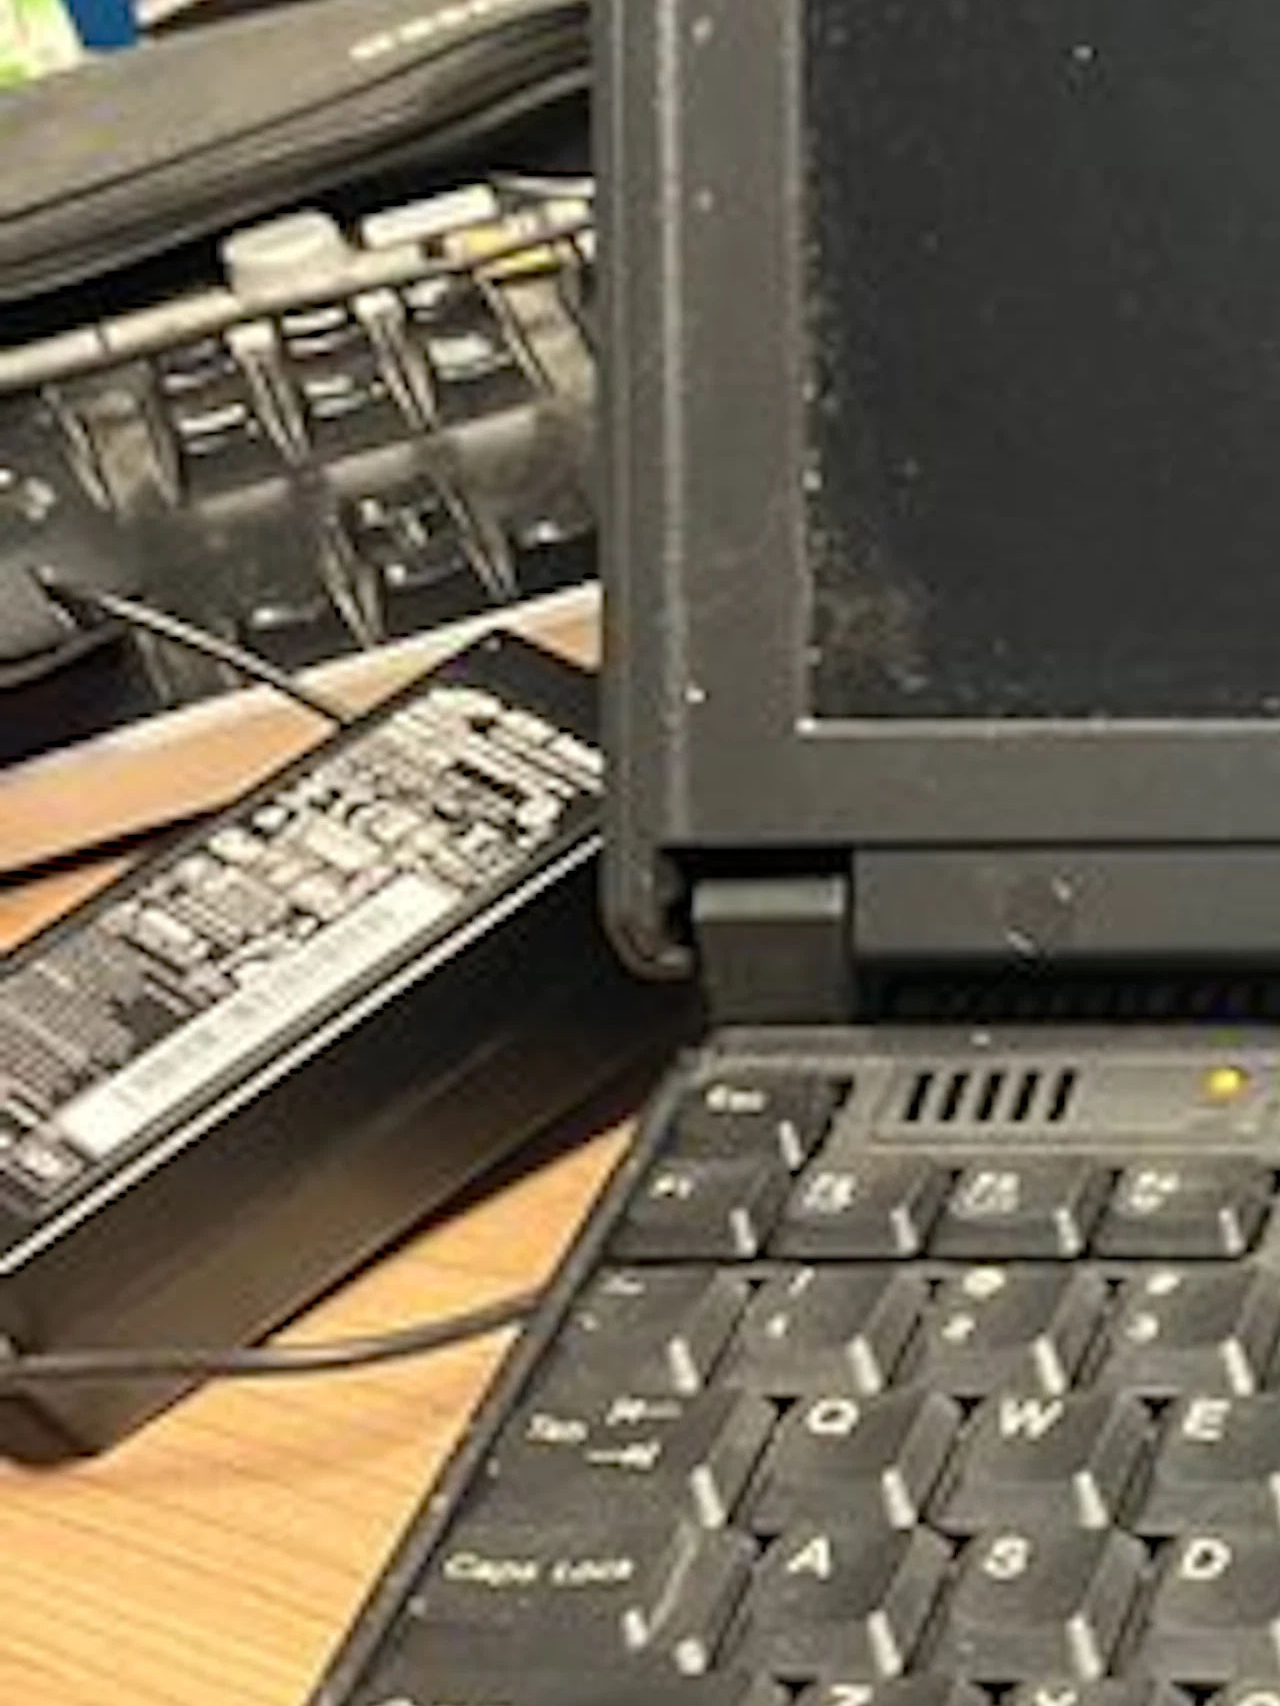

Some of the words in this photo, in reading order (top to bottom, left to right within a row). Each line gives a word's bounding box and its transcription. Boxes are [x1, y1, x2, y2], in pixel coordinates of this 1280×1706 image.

[805, 1397, 859, 1435] Q
[999, 1398, 1063, 1438] W
[1181, 1396, 1231, 1441] E
[785, 1535, 831, 1578] A
[981, 1536, 1029, 1579] S
[1179, 1537, 1231, 1581] D
